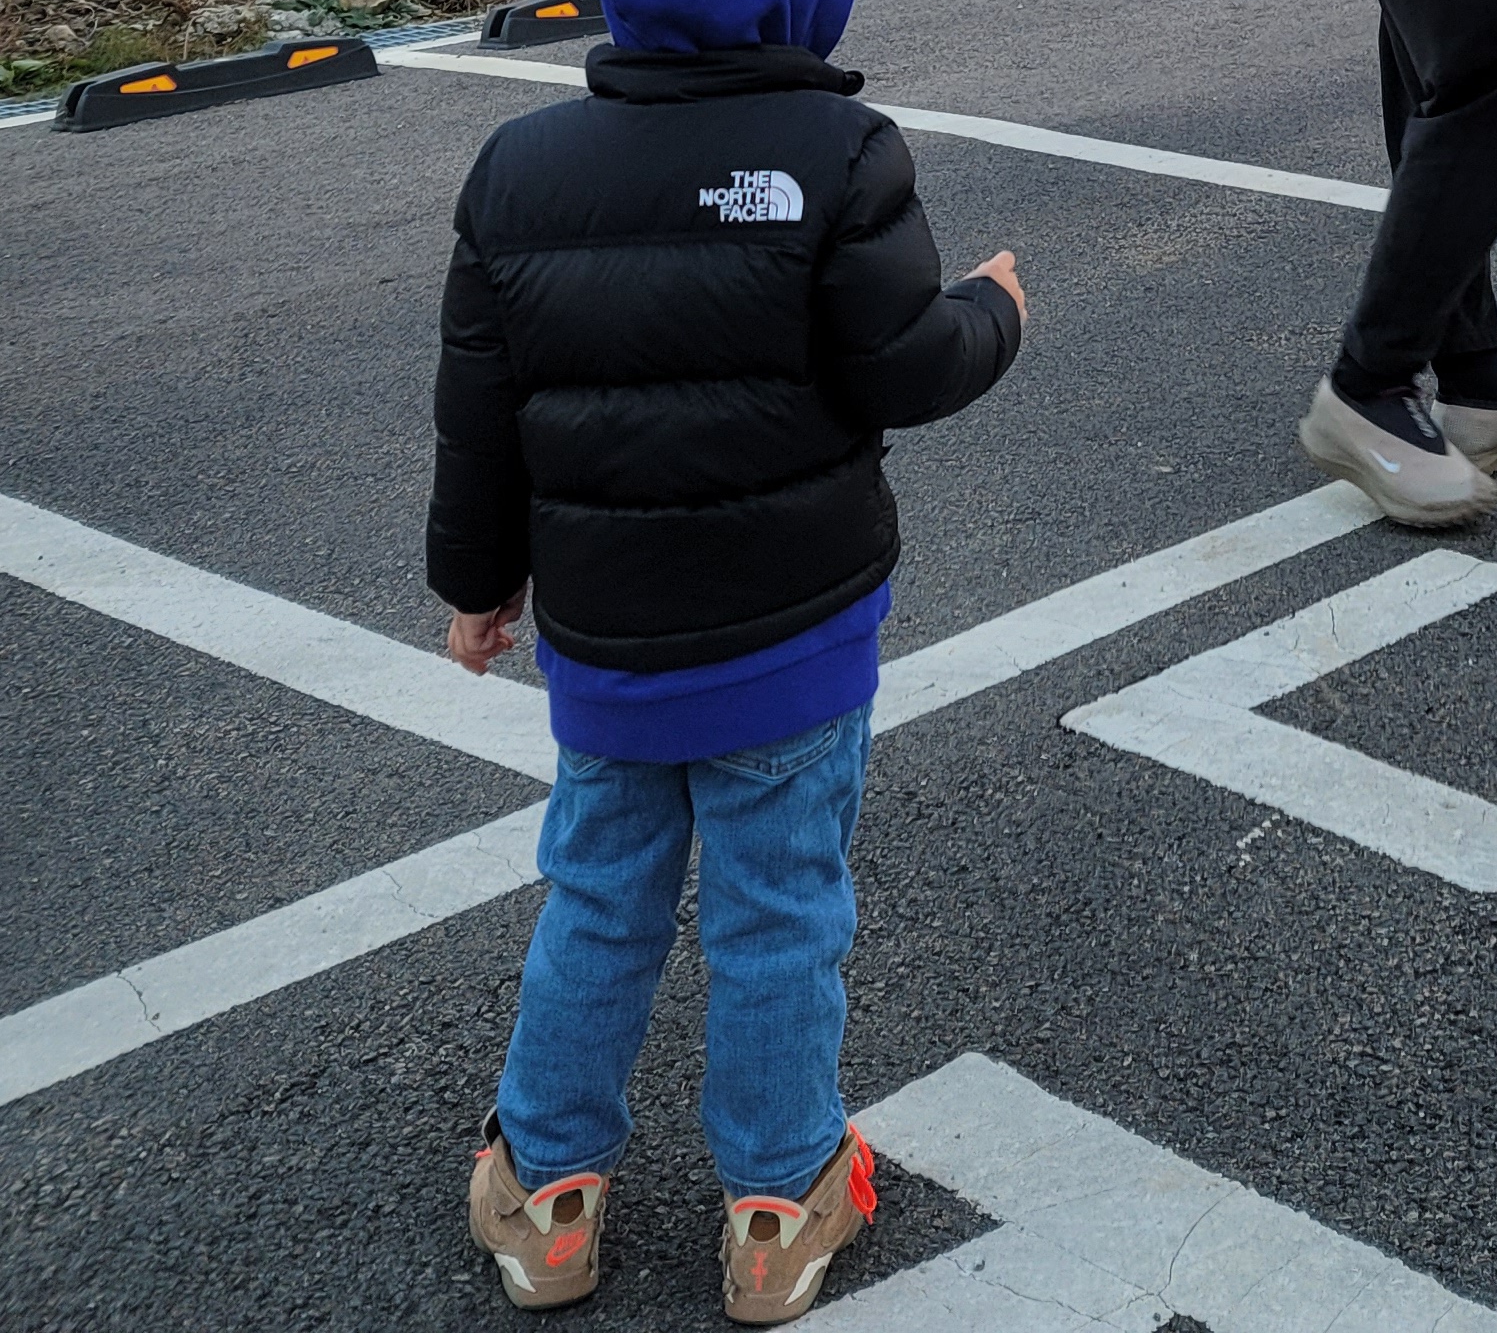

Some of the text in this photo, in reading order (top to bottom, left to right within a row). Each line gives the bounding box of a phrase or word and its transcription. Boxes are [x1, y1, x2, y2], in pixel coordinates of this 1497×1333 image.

[730, 170, 771, 188] THE
[698, 187, 769, 207] NORTH
[719, 204, 769, 223] FACE
